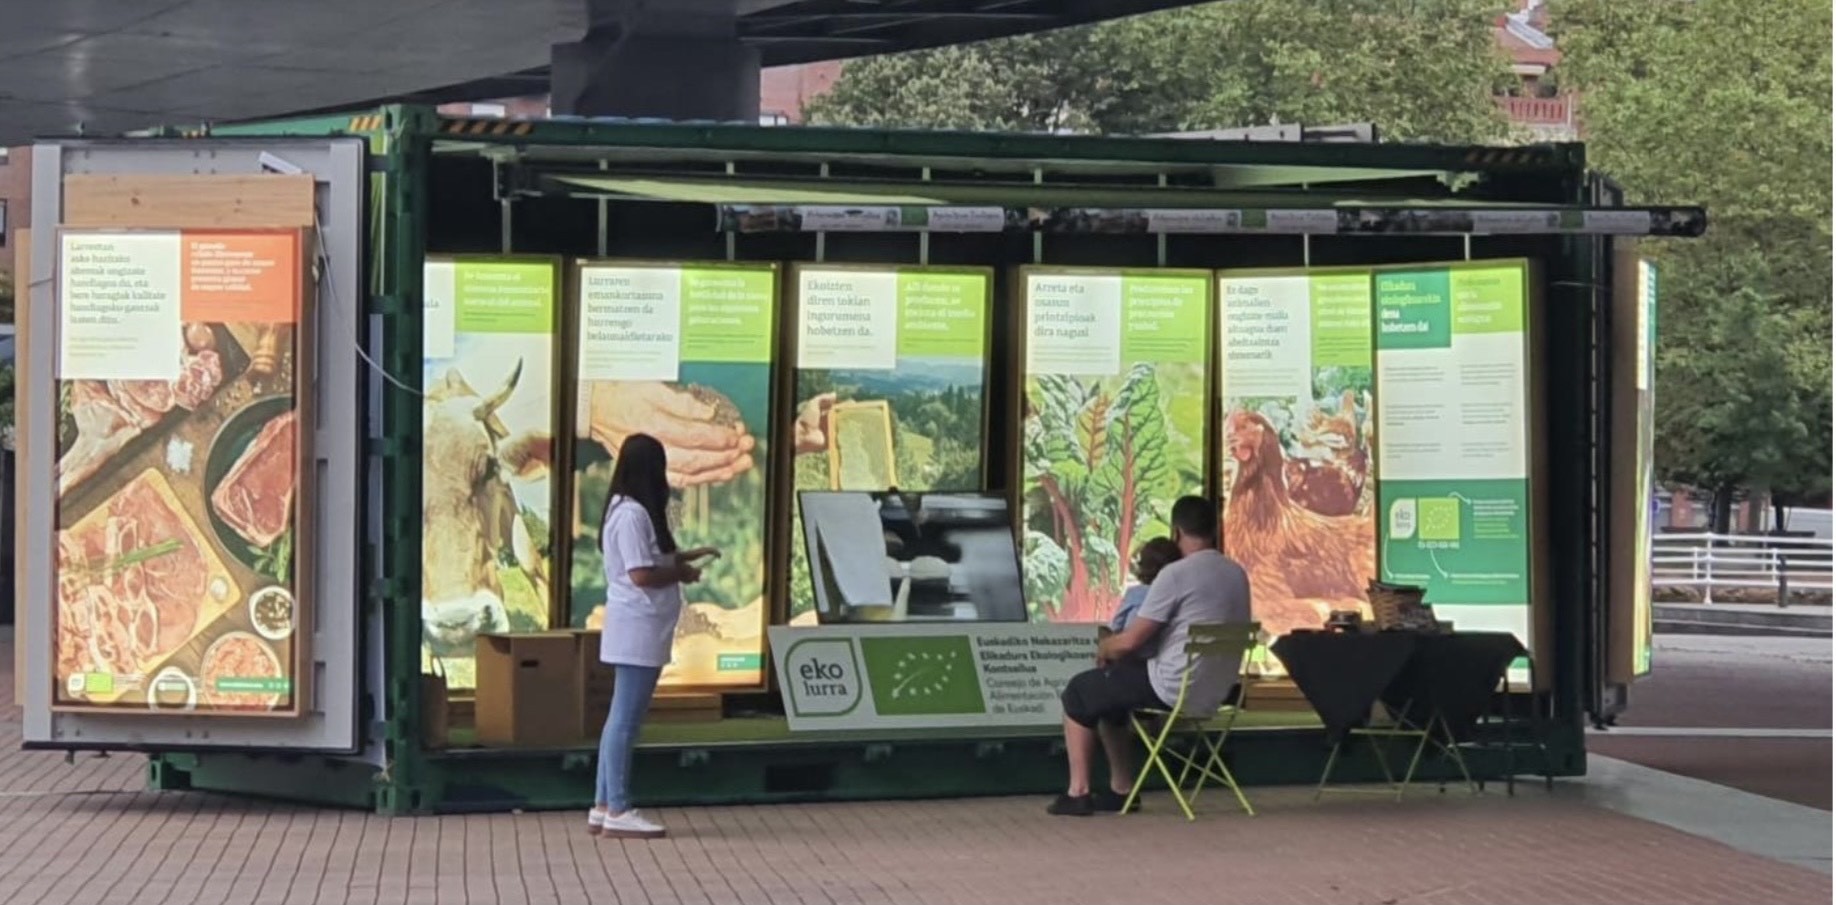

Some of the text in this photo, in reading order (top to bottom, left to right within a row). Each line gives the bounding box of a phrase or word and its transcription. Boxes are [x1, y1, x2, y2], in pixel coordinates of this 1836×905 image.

[588, 276, 630, 286] Lurraren
[807, 280, 853, 291] Ekoizten
[1035, 282, 1085, 294] Arreta eta
[807, 295, 872, 306] diren tokian
[807, 310, 872, 323] ingurumena
[807, 325, 856, 336] hobetzen
[1034, 326, 1090, 340] dira nagusi
[976, 635, 1029, 647] Euskadiko
[1030, 635, 1091, 646] Nekazaritza
[979, 650, 1028, 661] Elikadura
[799, 657, 843, 681] eko
[983, 663, 1038, 673] Kontseilua
[803, 680, 847, 697] lurra
[985, 677, 1027, 690] Consejo
[1028, 676, 1041, 688] de
[990, 689, 1056, 701] Alimentación
[992, 702, 1046, 714] de Euskadi
